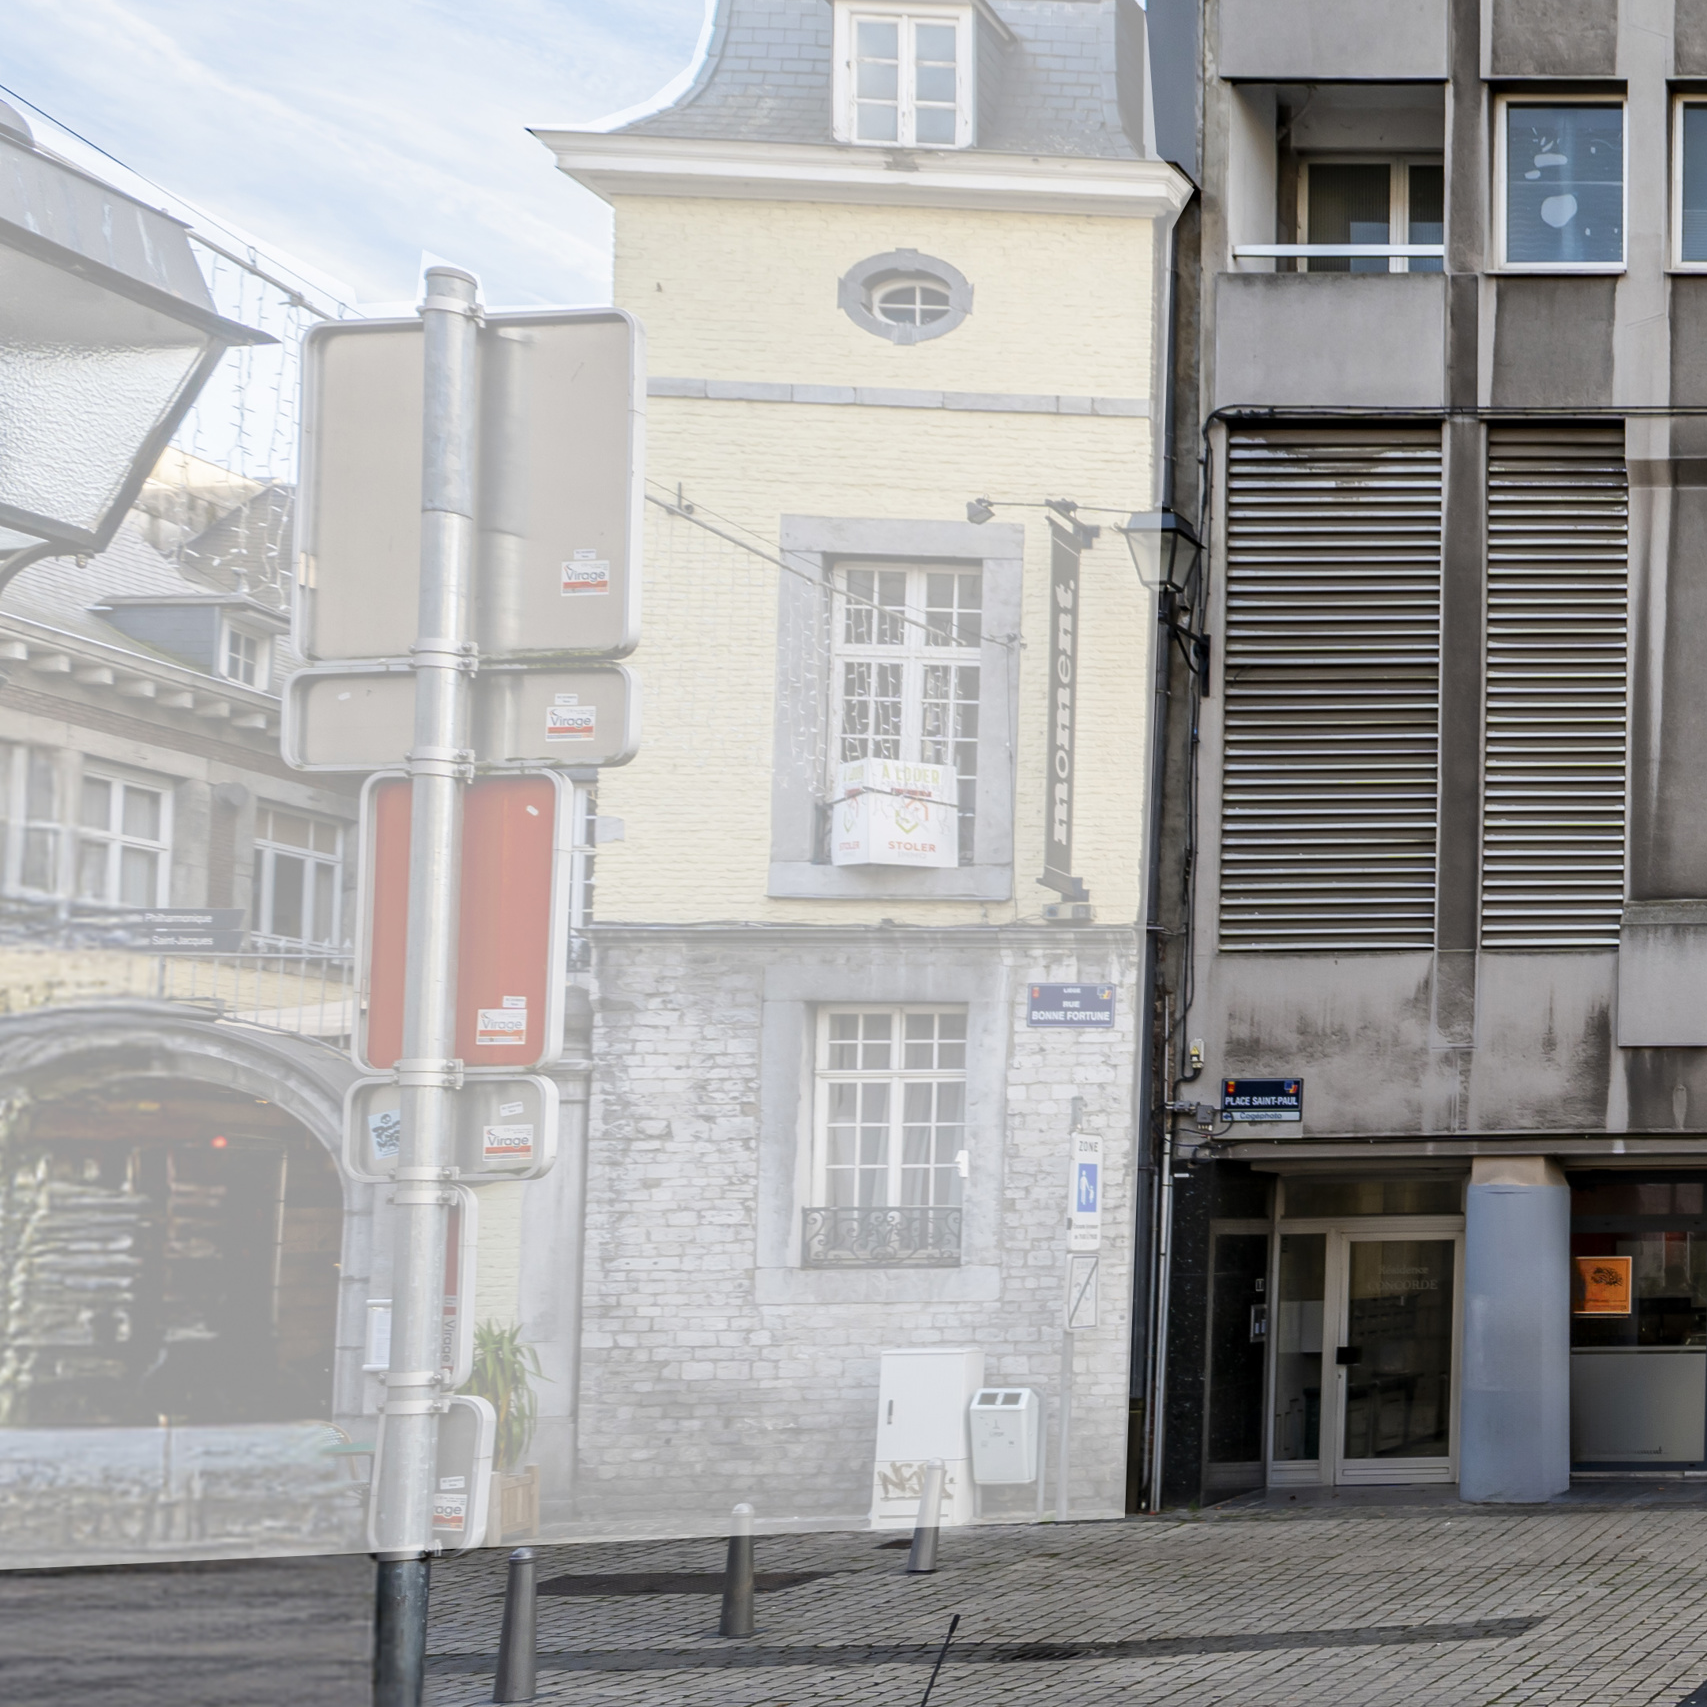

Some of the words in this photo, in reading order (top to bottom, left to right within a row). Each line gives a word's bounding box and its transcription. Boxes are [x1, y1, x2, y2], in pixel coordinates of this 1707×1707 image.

[564, 568, 606, 583] Virage
[1053, 579, 1076, 845] moment.
[550, 716, 592, 729] Virage
[895, 765, 940, 785] LOUER
[888, 841, 936, 852] STOLER
[144, 913, 213, 925] Philharmonique
[152, 935, 213, 947] Saint-Jacques
[1062, 1000, 1081, 1008] RUE
[1031, 1010, 1065, 1021] BONNE
[1066, 1011, 1110, 1021] FORTUNE
[481, 1019, 523, 1032] Virage
[1225, 1096, 1251, 1106] PLACE
[1252, 1096, 1298, 1106] SAINT-PAUL
[487, 1135, 530, 1148] Virage
[1078, 1140, 1099, 1153] ZONE
[441, 1319, 456, 1363] Virage
